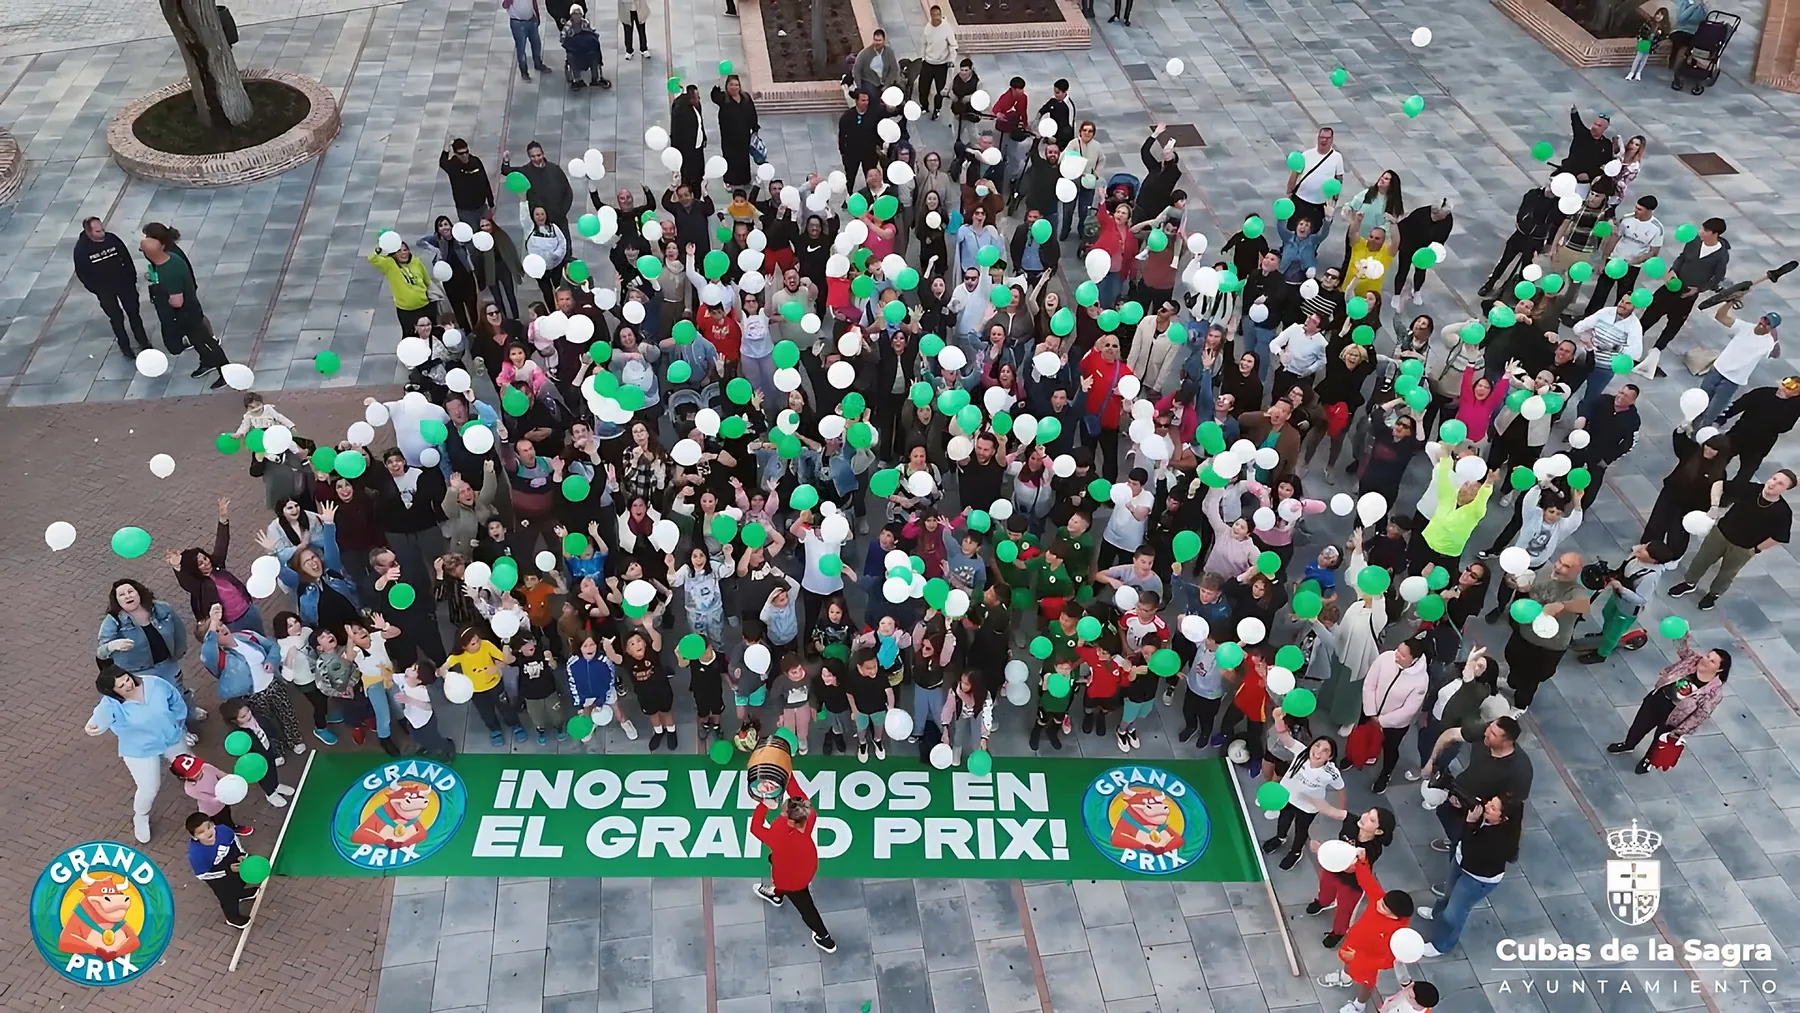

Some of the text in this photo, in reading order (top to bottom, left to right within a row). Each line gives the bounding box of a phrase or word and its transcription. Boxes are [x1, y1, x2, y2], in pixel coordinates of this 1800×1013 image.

[362, 761, 457, 792] GRAND
[952, 771, 1050, 812] EN
[1095, 766, 1187, 798] GRAND
[471, 815, 564, 858] EL
[873, 817, 1070, 861] PRIX!
[351, 844, 421, 867] PRIX
[1120, 847, 1188, 871] PRIX
